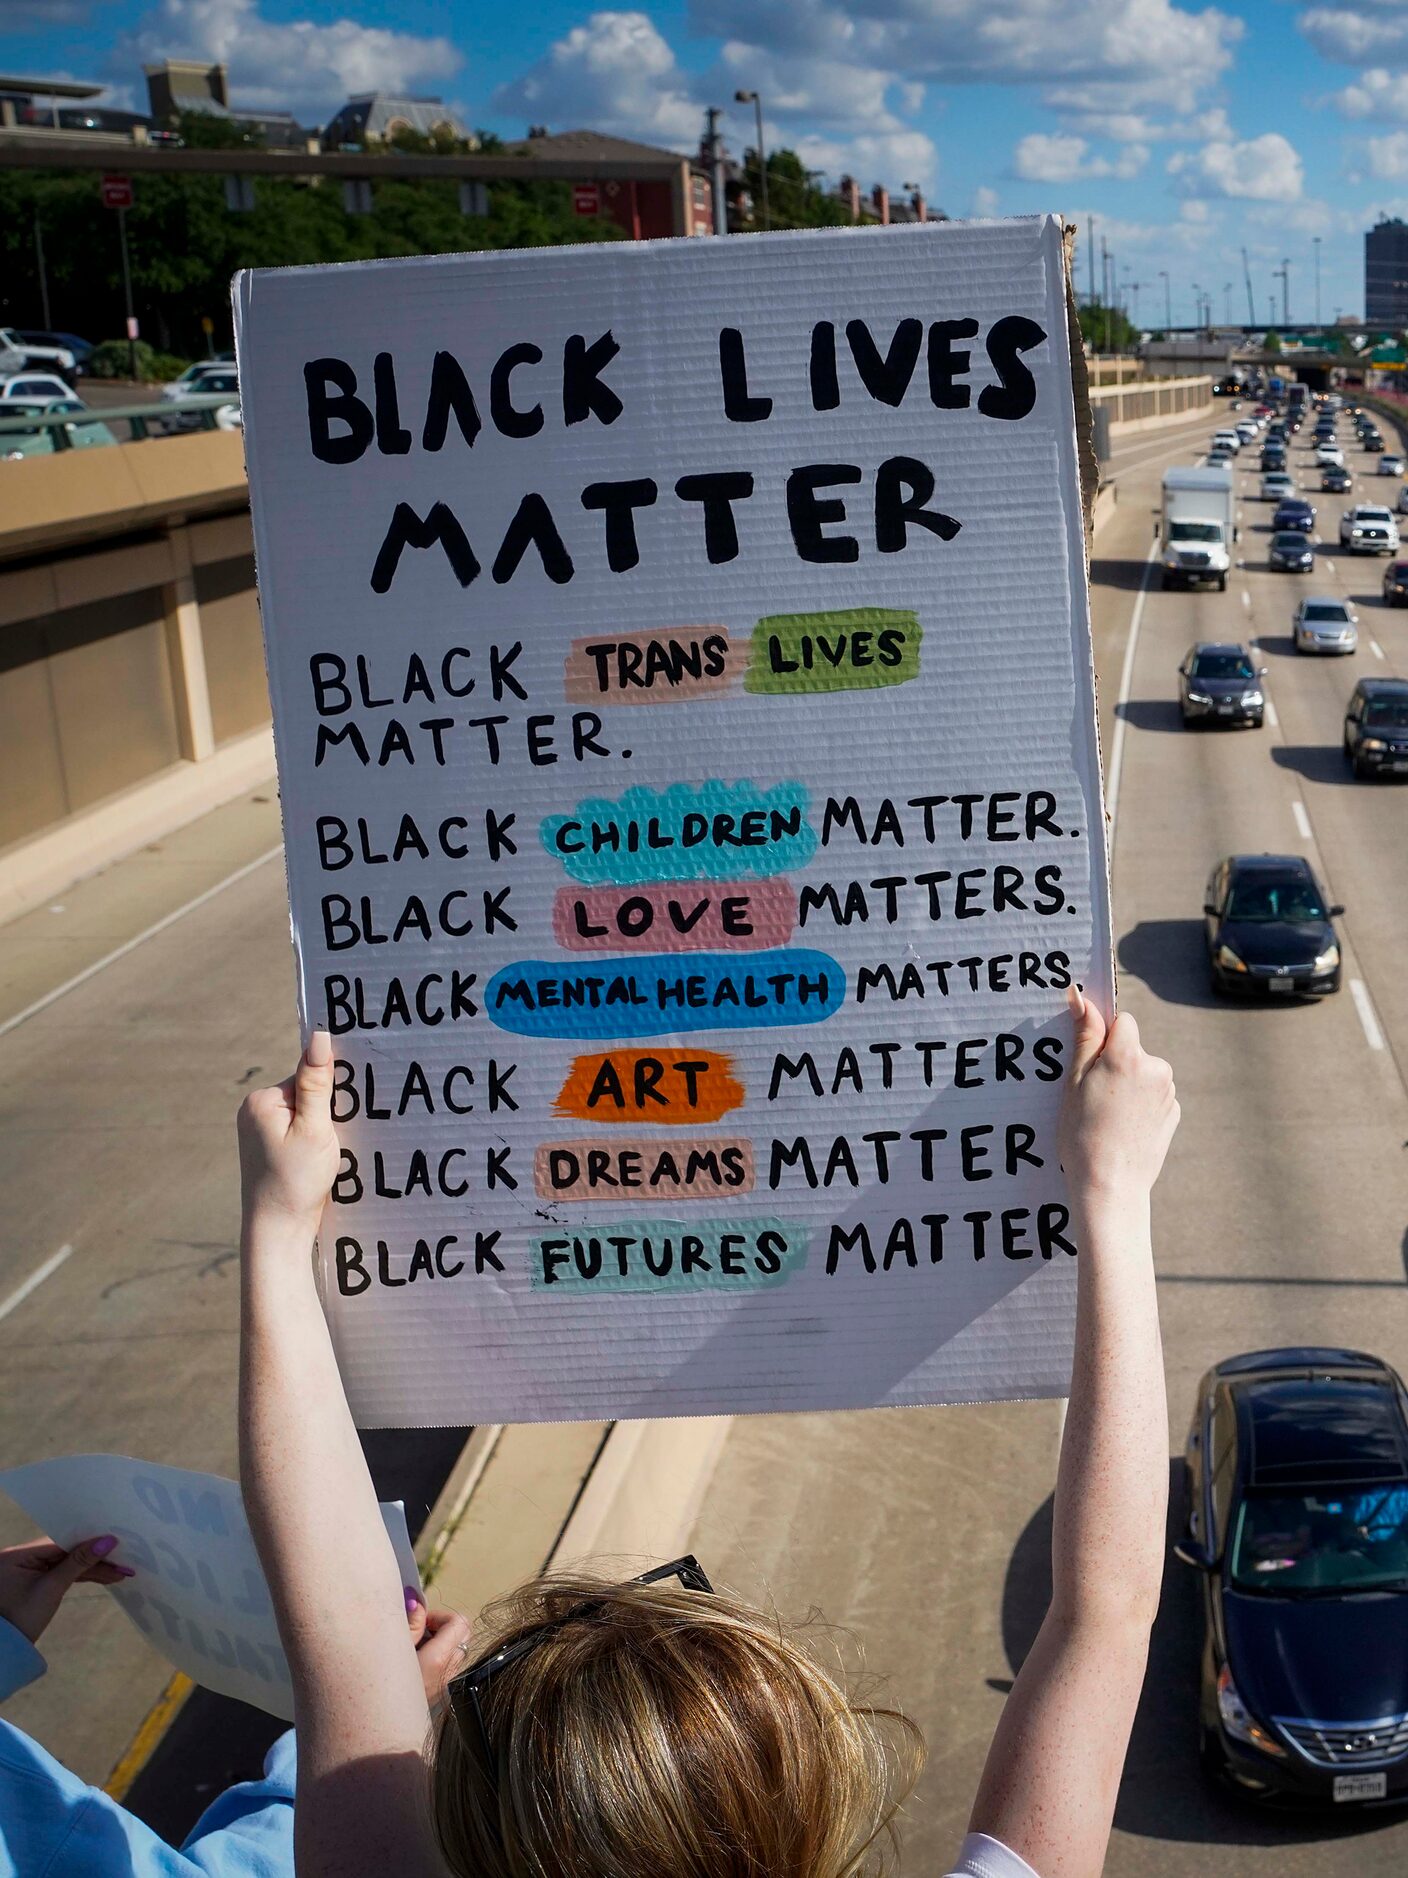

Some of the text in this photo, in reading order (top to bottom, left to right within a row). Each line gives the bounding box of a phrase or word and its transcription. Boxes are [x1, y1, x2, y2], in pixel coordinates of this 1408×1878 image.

[304, 316, 1047, 464] BLACK LIVES
[371, 456, 962, 593] MATTER
[310, 629, 906, 716] BLACK TRANS LIVES
[315, 711, 633, 768] MATTER.
[316, 790, 1080, 871] BLACK CHILDREN MATTER.
[321, 865, 1077, 951] BLACK LOVE MATTERS.
[324, 970, 479, 1035] BLACK
[495, 974, 649, 1015] MENTAL
[656, 970, 830, 1012] HEALTH
[330, 1036, 1064, 1123] BLACK ART MATTERS
[332, 1124, 1065, 1204] BLACK DREAMS MATTER
[336, 1202, 1078, 1297] BLACK FUTURES MATTER
